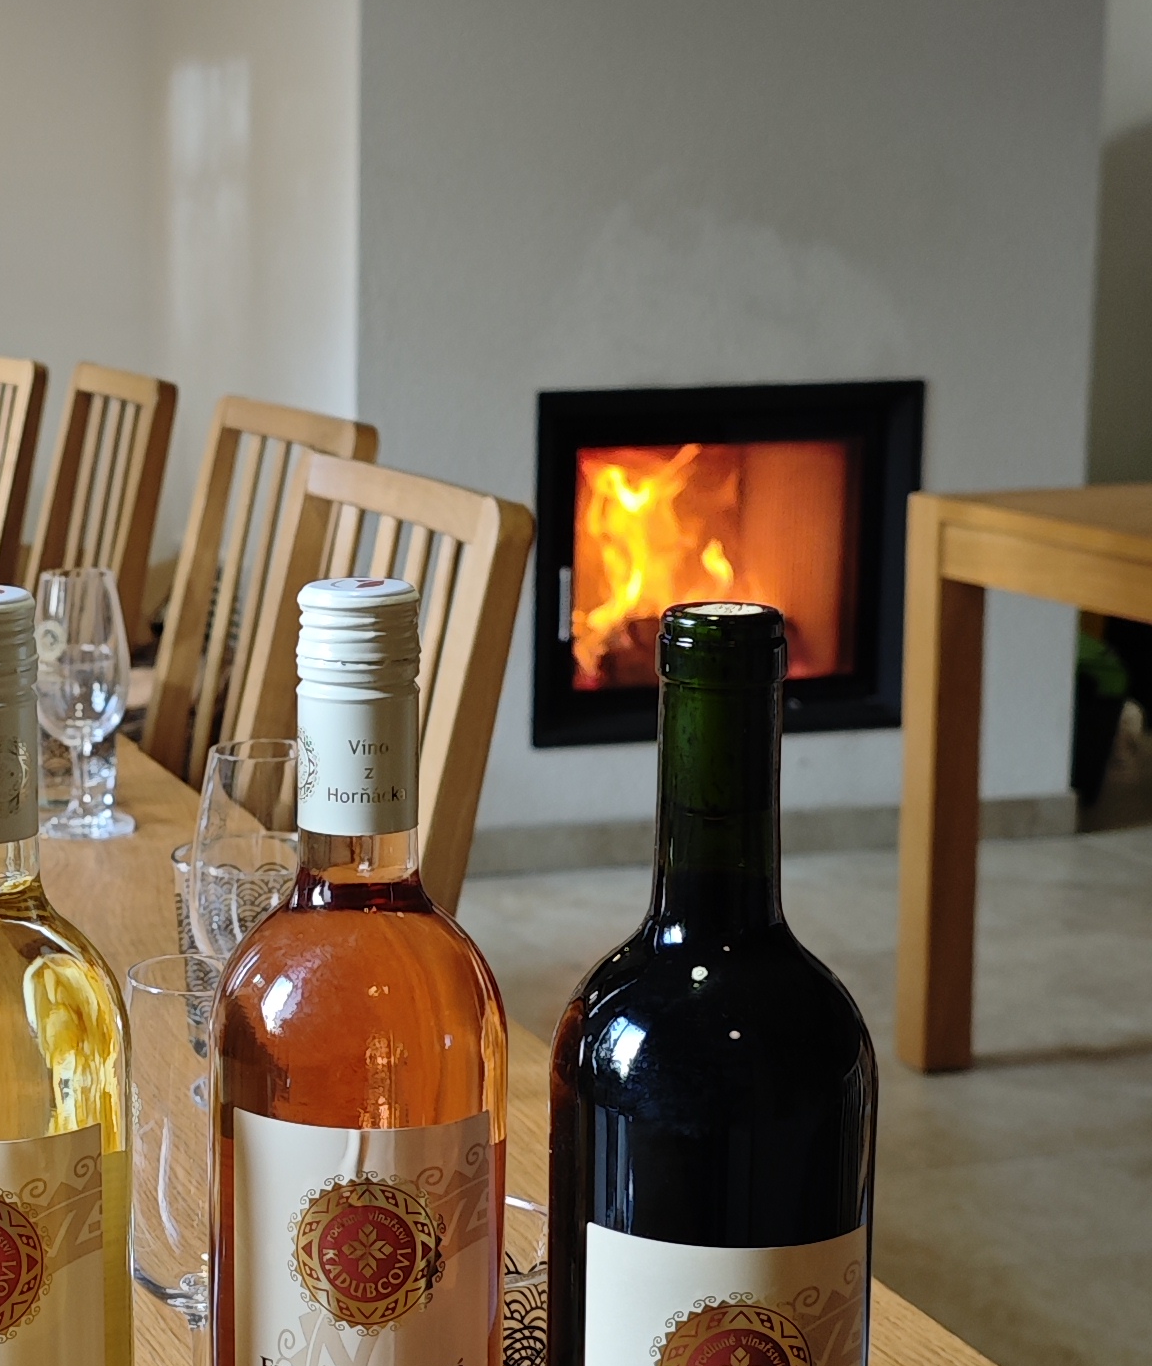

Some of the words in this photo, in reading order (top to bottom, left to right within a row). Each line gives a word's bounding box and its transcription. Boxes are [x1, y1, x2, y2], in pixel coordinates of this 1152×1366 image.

[348, 739, 389, 755] Víno
[364, 767, 374, 779] z
[368, 1209, 412, 1244] vinařství
[322, 1248, 413, 1298] KADUBCOVI
